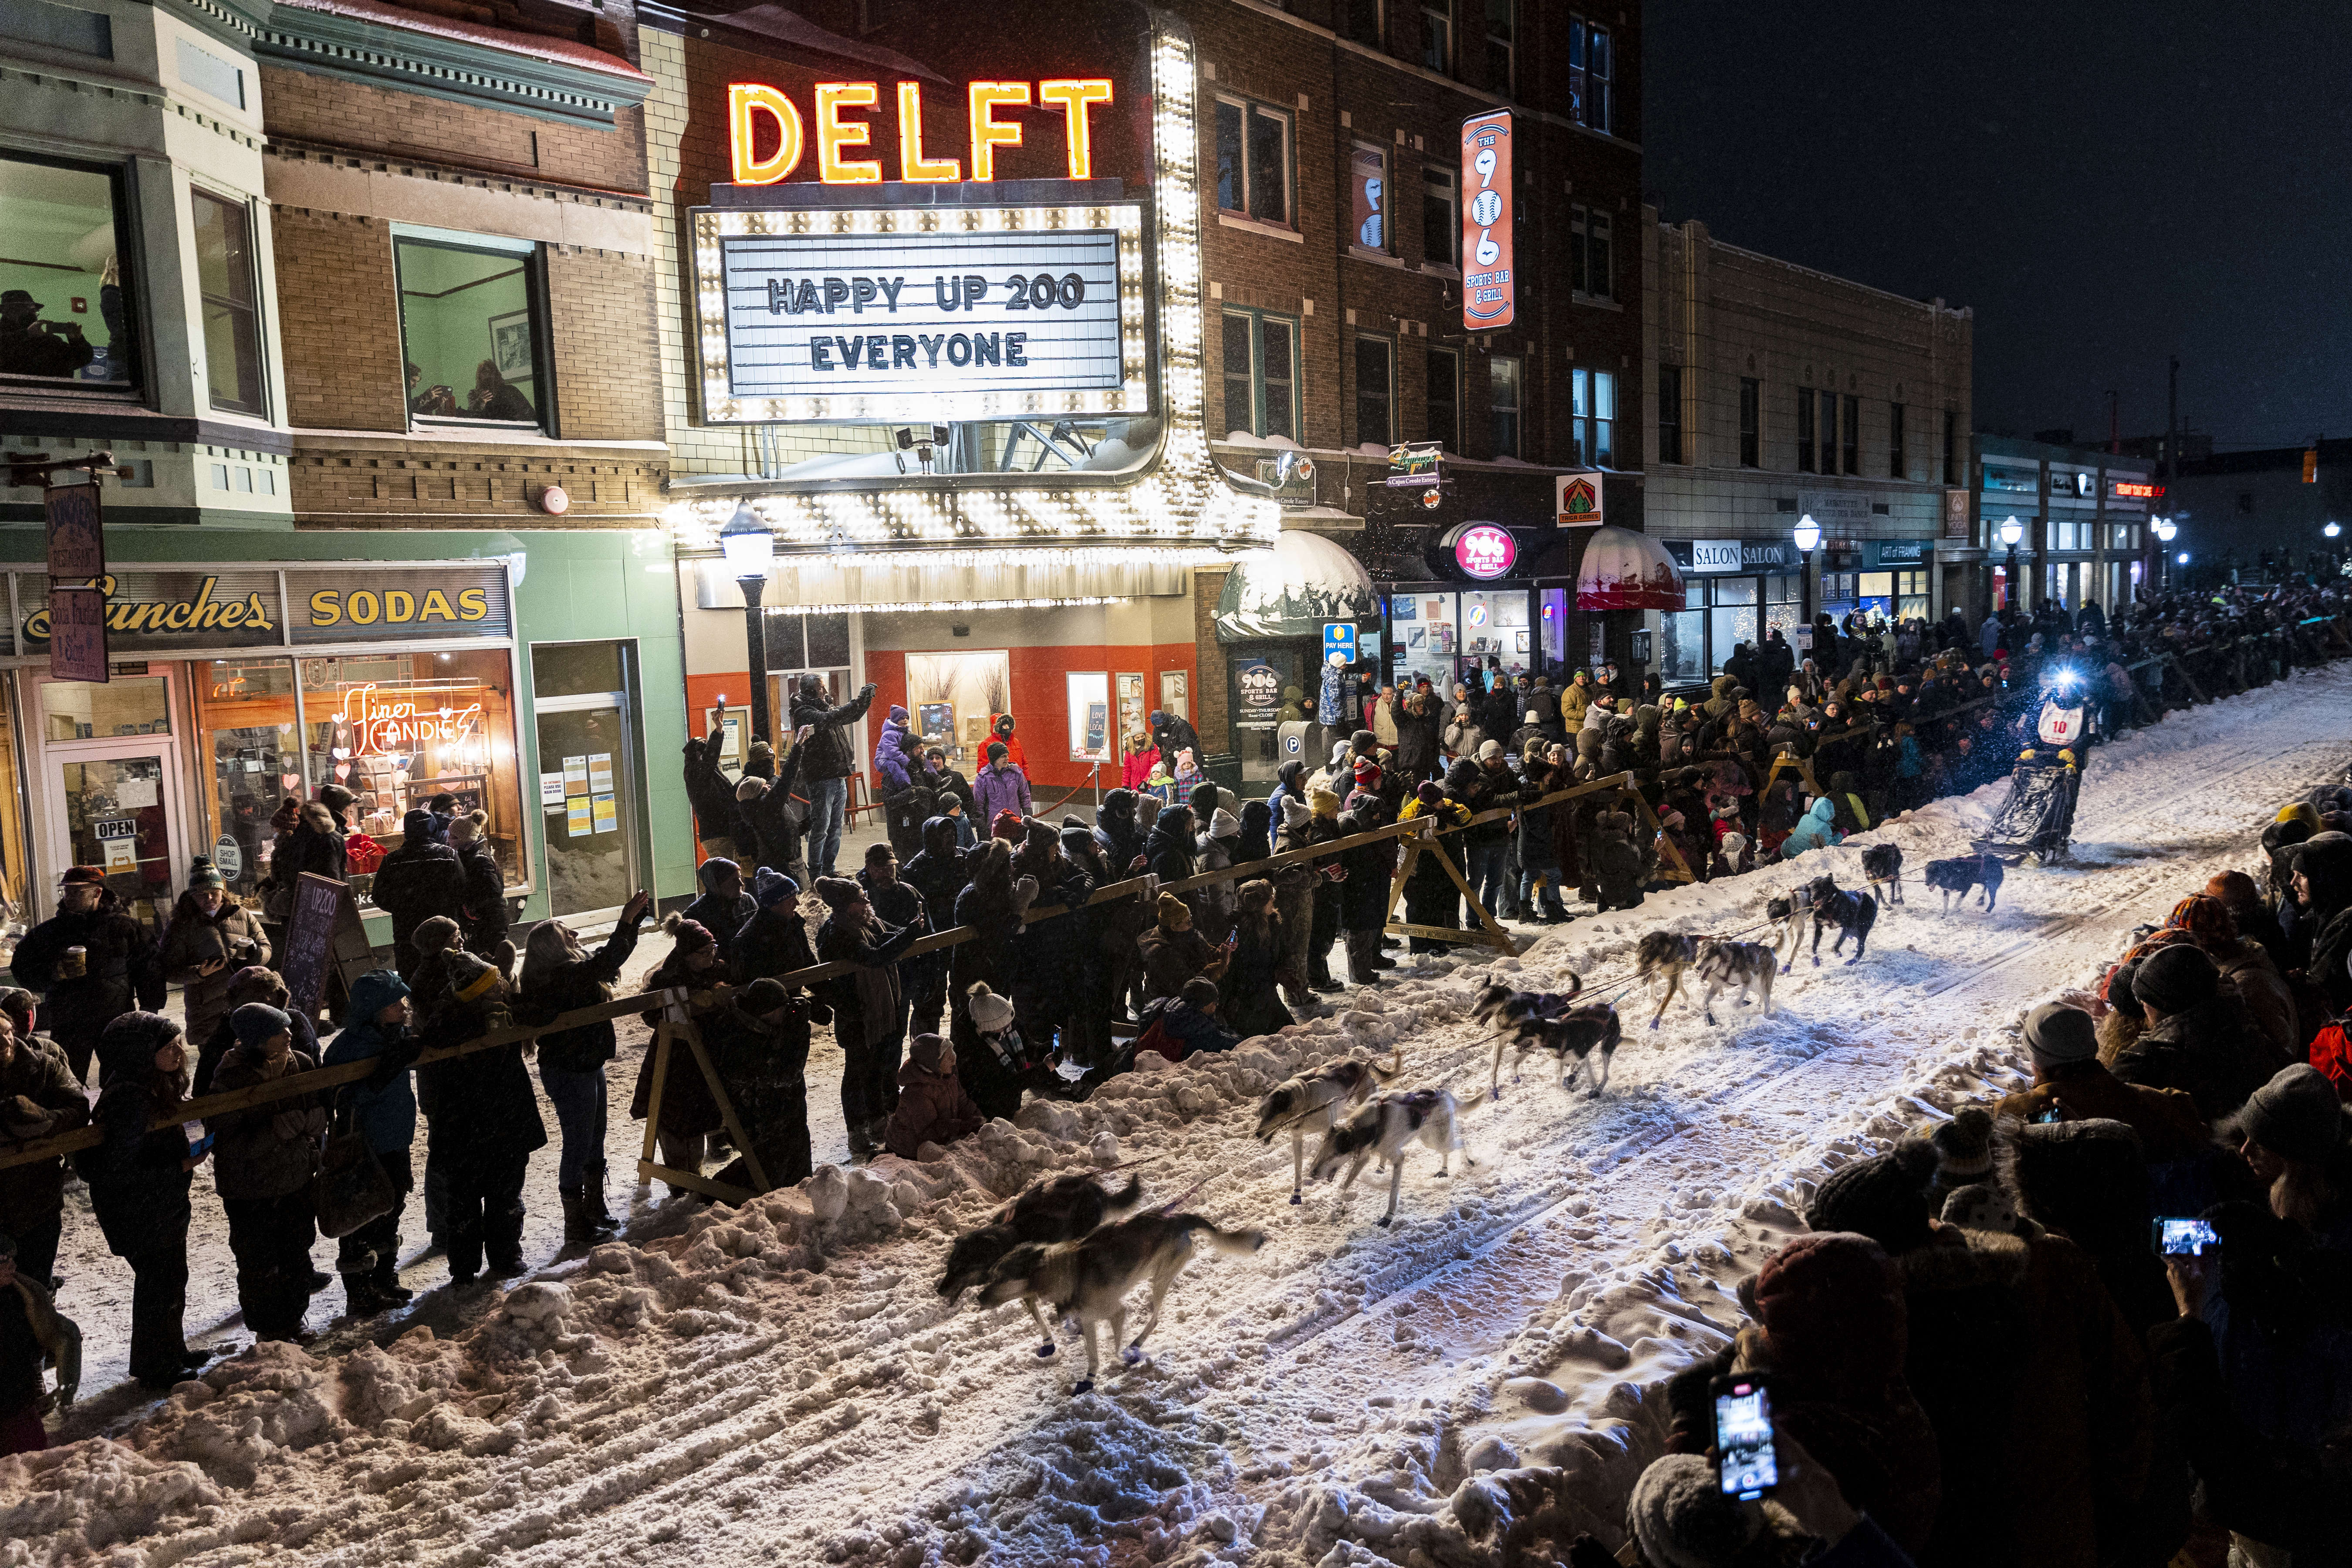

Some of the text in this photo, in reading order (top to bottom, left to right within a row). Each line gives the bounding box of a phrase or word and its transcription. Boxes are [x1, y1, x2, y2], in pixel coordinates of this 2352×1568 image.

[728, 78, 1114, 186] DELFT
[1478, 135, 1495, 147] THE
[1471, 148, 1502, 267] 906
[1466, 270, 1510, 288] SPORTS BAR
[768, 272, 1086, 315] HAPPY UP 200
[1475, 288, 1503, 304] & GRILL
[810, 332, 1029, 372] EVERYONE
[1390, 448, 1436, 472] Lagniappe
[1465, 535, 1505, 558] 906
[1881, 546, 1921, 558] ART of FRAMING
[1696, 547, 1739, 564] SALON
[1743, 547, 1783, 564] SALON
[310, 587, 489, 627] SODAS
[1241, 673, 1277, 689] 906
[369, 703, 482, 755] CANDIES
[1089, 723, 1105, 731] LOCAL
[2052, 721, 2067, 734] 10
[1290, 739, 1298, 751] P
[98, 821, 134, 838] OPEN
[220, 849, 235, 858] SHOP
[220, 857, 237, 866] SMALL
[311, 886, 337, 916] UP200
[1399, 926, 1424, 937] NORTHERN
[1426, 930, 1449, 940] MICHIGAN
